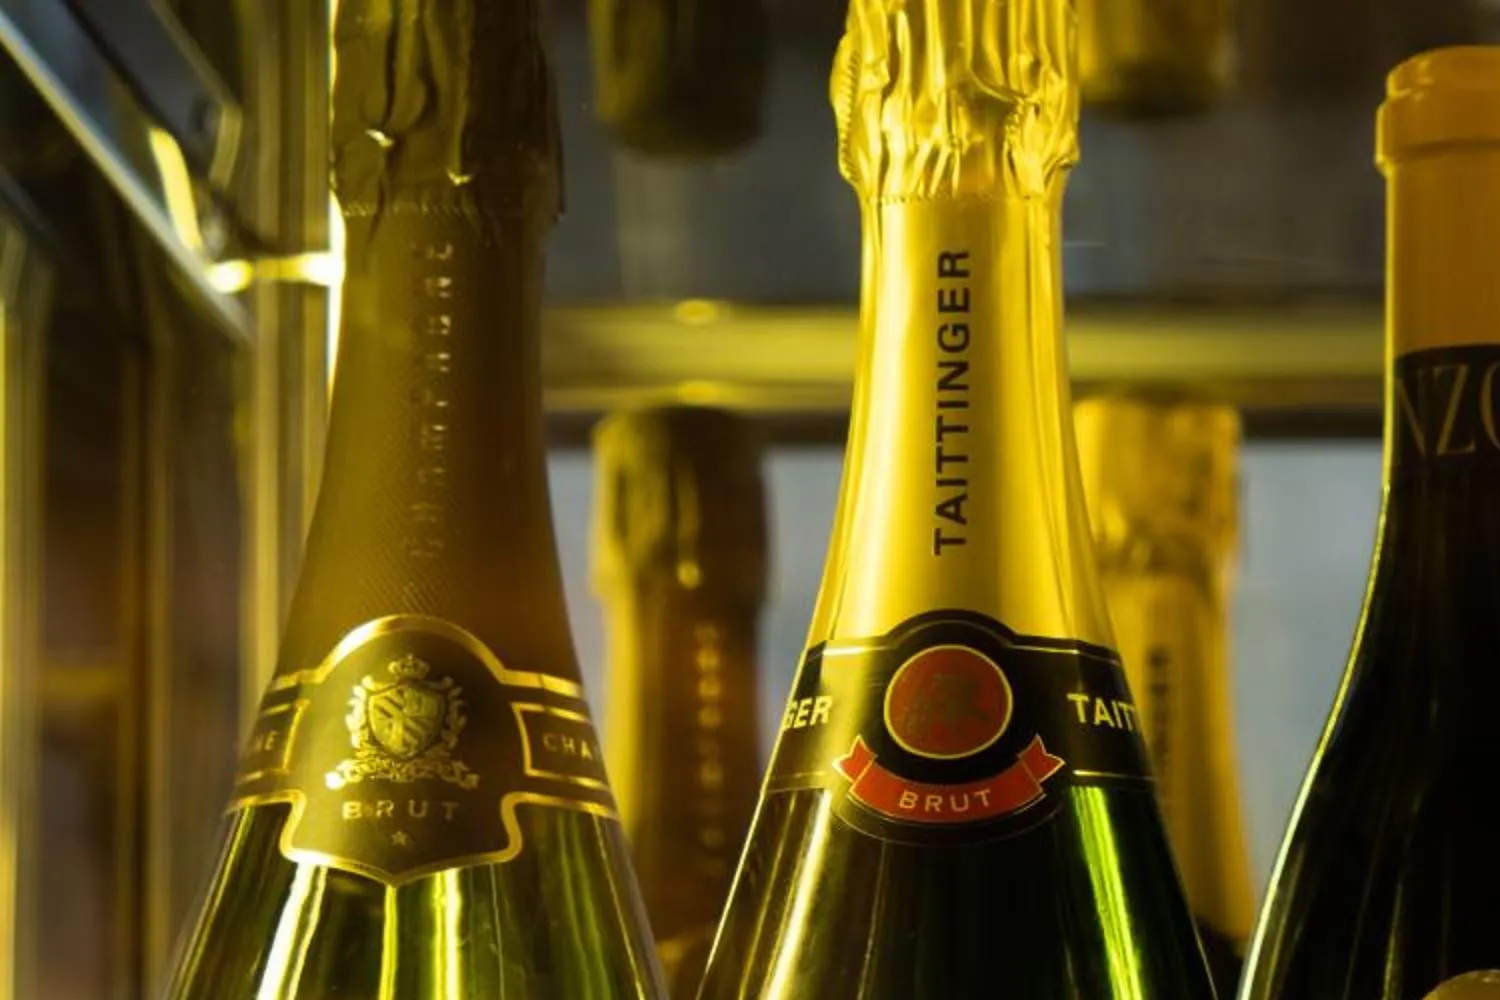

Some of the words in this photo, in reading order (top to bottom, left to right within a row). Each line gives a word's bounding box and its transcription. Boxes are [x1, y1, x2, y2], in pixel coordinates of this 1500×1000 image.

[934, 251, 971, 556] TAITTINGER
[341, 800, 460, 821] BRUT
[899, 788, 993, 814] BRUT
